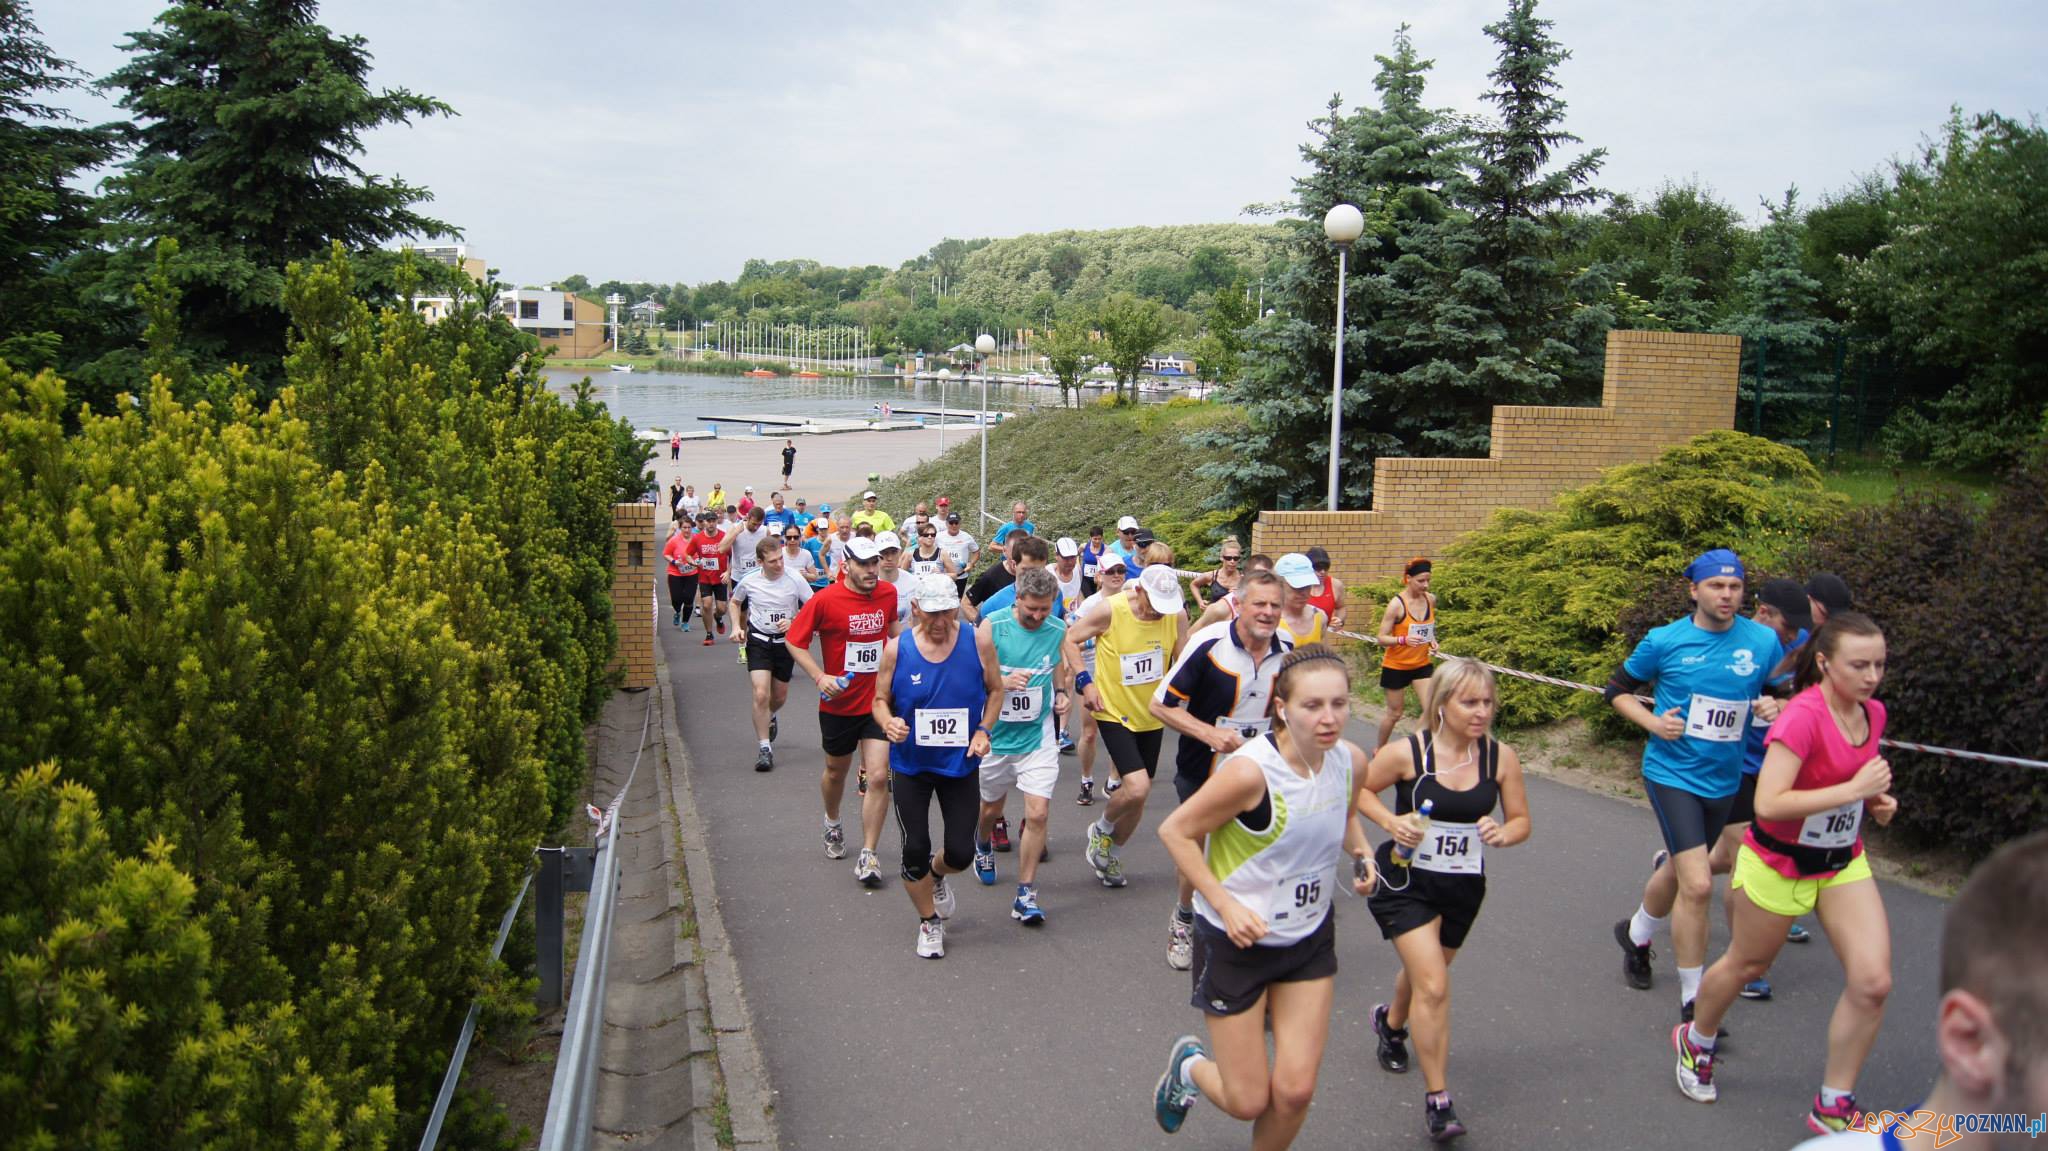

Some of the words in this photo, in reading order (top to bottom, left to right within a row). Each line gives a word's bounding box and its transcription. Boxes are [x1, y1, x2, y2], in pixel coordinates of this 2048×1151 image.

[849, 617, 885, 630] SZPIKU
[856, 649, 877, 662] 168
[1134, 658, 1152, 674] 177
[1012, 696, 1030, 711] 90
[929, 718, 957, 734] 192
[1706, 709, 1737, 728] 106
[1826, 810, 1856, 833] 165
[1435, 835, 1469, 856] 154
[1295, 879, 1321, 908] 95
